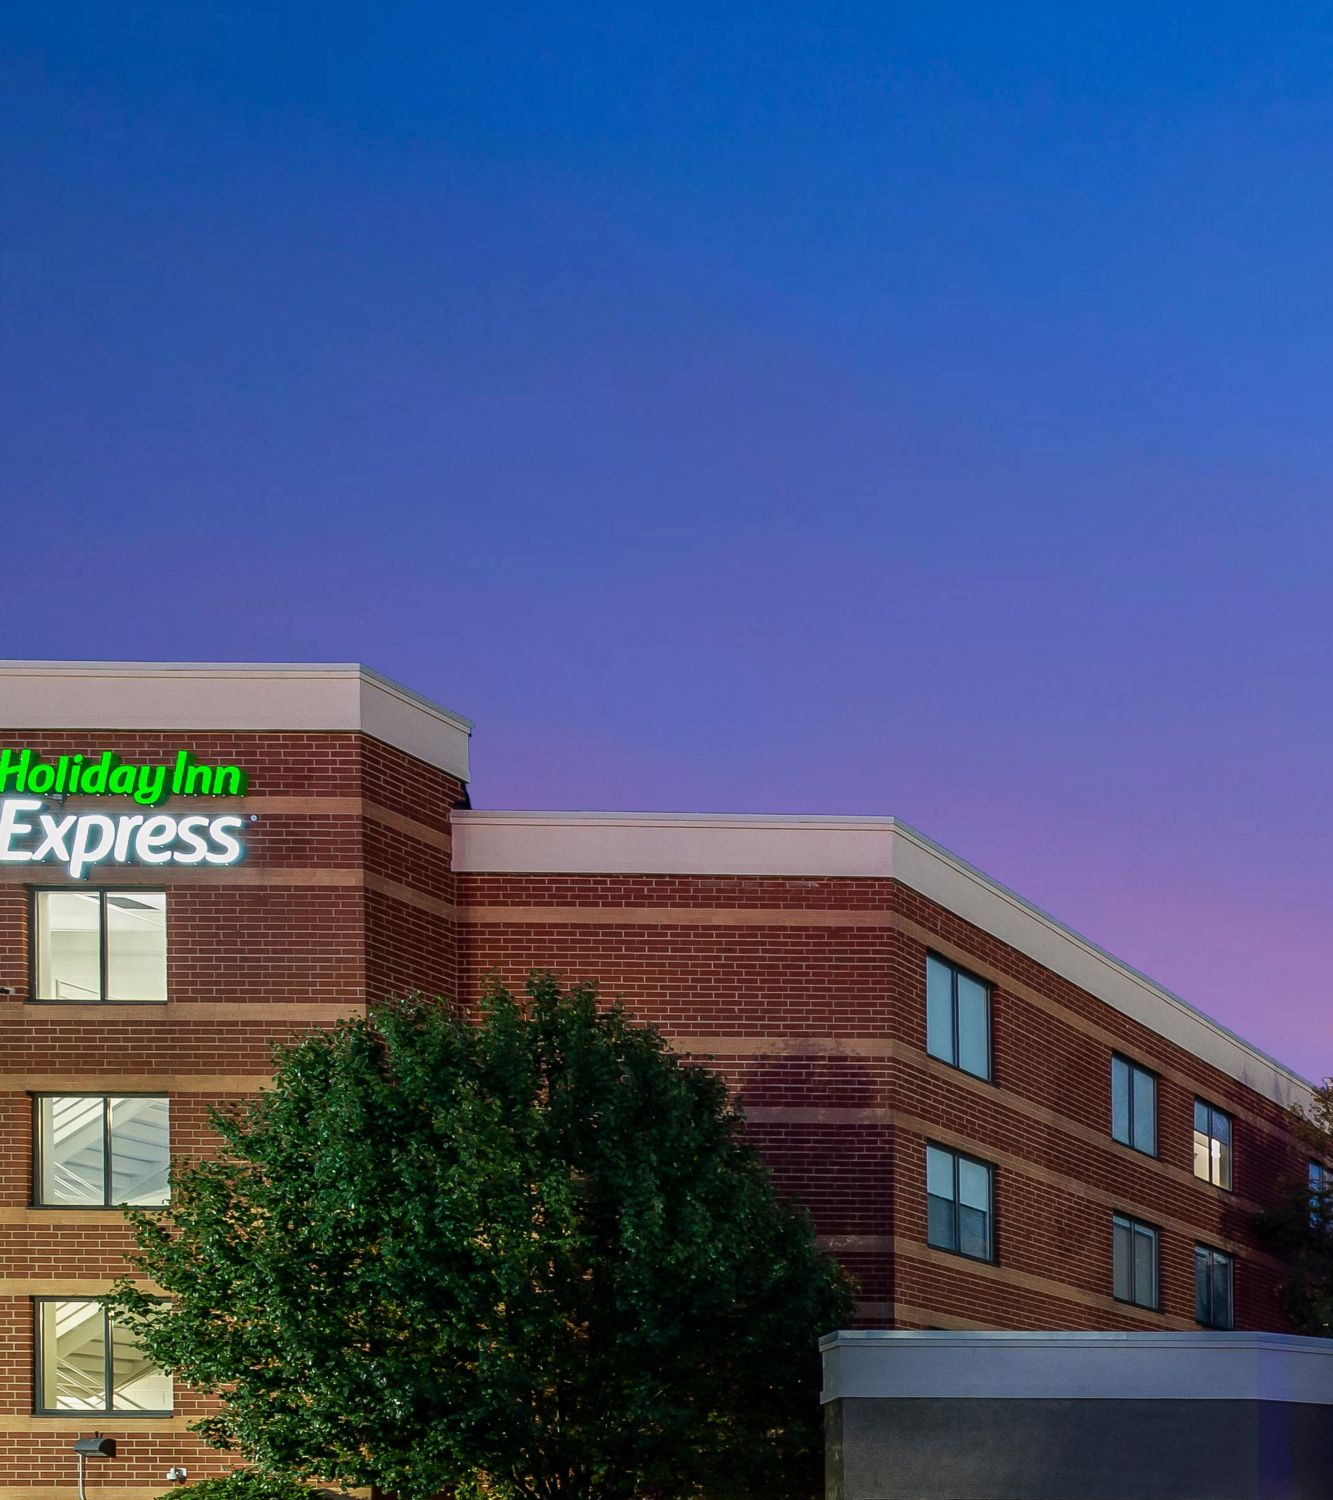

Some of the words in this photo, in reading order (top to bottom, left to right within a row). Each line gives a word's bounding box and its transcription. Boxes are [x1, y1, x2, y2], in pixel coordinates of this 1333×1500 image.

[0, 749, 165, 804] Holiday
[172, 750, 242, 794] Inn
[0, 799, 243, 878] Express
